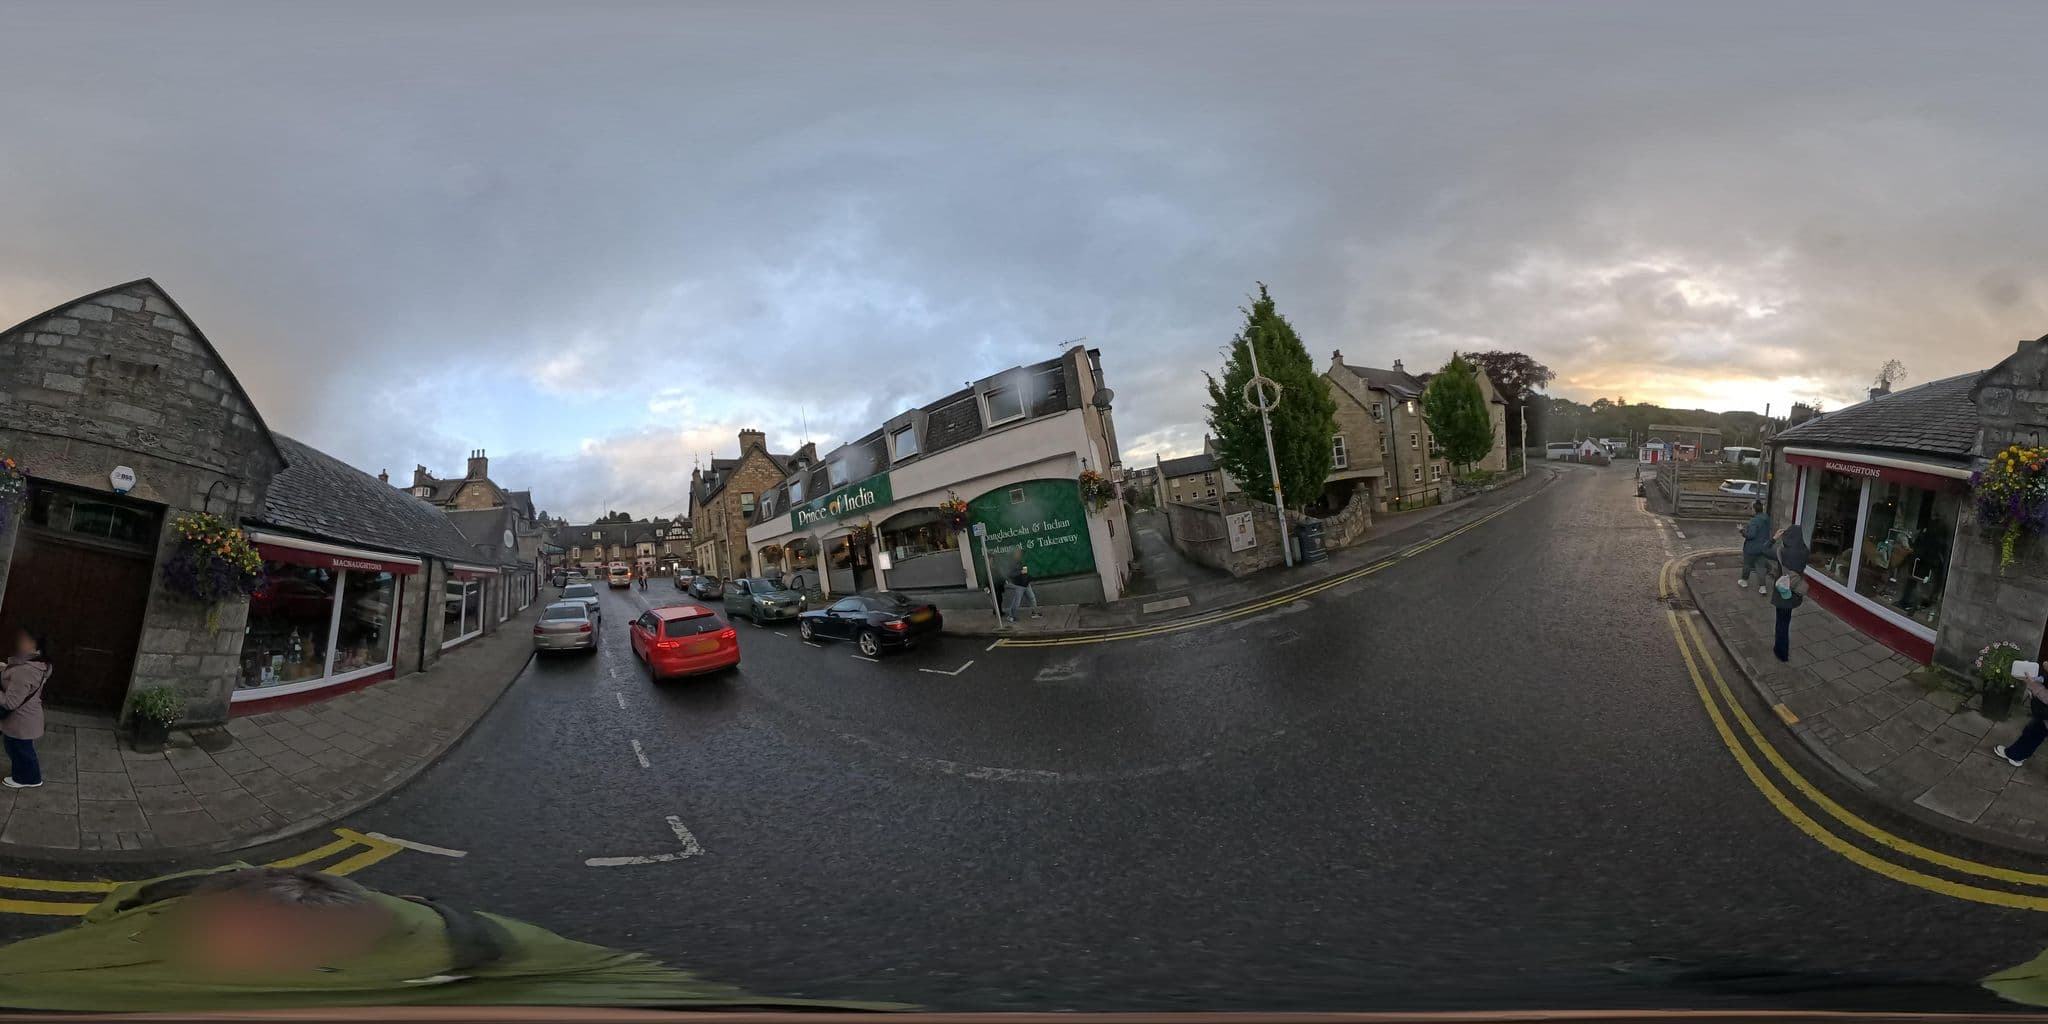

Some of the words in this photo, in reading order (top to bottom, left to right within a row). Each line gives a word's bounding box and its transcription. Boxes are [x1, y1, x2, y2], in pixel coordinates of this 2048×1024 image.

[1825, 461, 1881, 478] MACNAUGHTONS
[798, 507, 827, 526] Prince
[829, 494, 842, 516] of
[843, 487, 876, 512] India
[1032, 522, 1040, 533] &
[1043, 518, 1071, 531] Indian
[981, 541, 1023, 556] staurnt
[1026, 539, 1035, 549] &
[1037, 533, 1079, 548] Takeaway
[332, 558, 382, 571] MACNAUGHTONS
